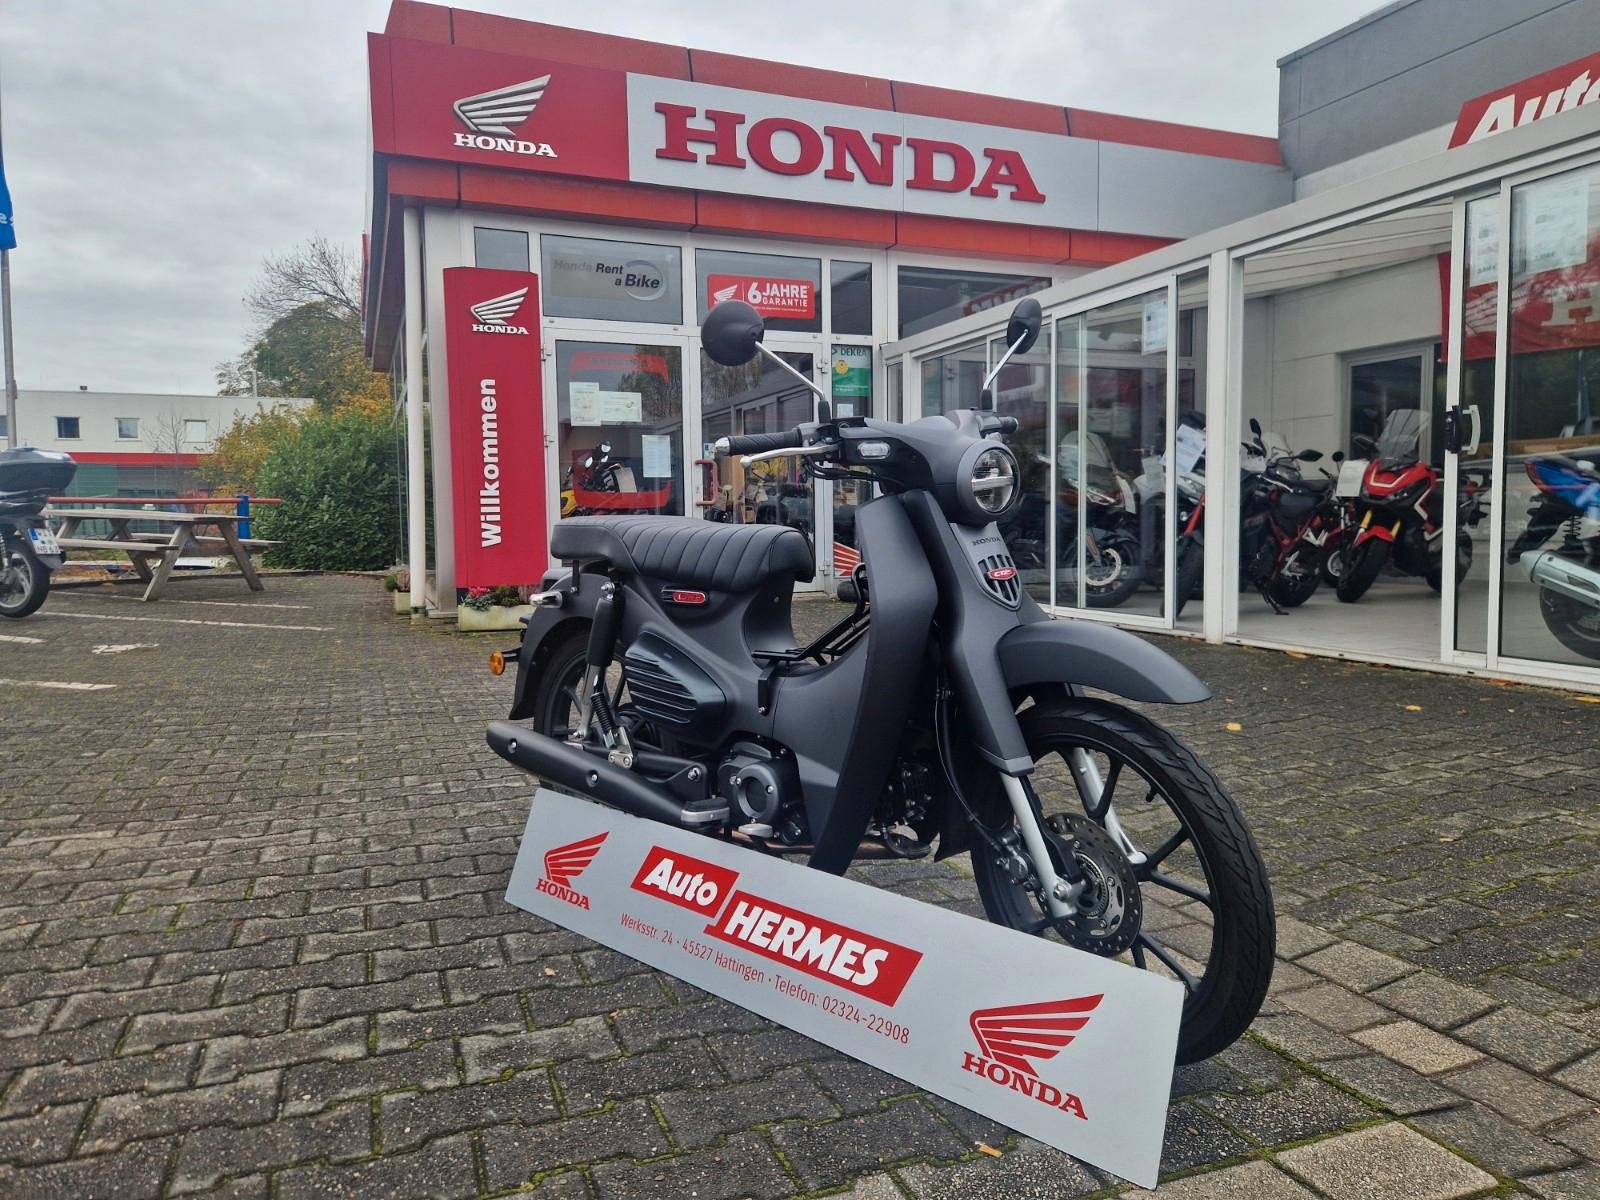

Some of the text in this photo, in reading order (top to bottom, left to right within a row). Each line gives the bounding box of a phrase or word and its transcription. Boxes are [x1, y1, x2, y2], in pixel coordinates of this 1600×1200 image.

[453, 133, 558, 158] HONDA
[655, 102, 1046, 203] HONDA
[553, 259, 624, 275] Honda Rent
[615, 273, 660, 289] a Bike
[747, 281, 762, 304] 6
[762, 297, 808, 307] GARANTIE
[472, 323, 529, 335] HONDA
[840, 347, 867, 357] DEKRA
[480, 378, 502, 547] Willkommen
[972, 536, 1001, 546] HONDA
[535, 878, 590, 911] HONDA
[642, 858, 718, 907] Auto
[724, 900, 889, 987] HERMES
[620, 911, 910, 1044] Werksstr. 24 45527 Hattingen Telefon: 02324-22908
[961, 1051, 1089, 1121] HONDA
